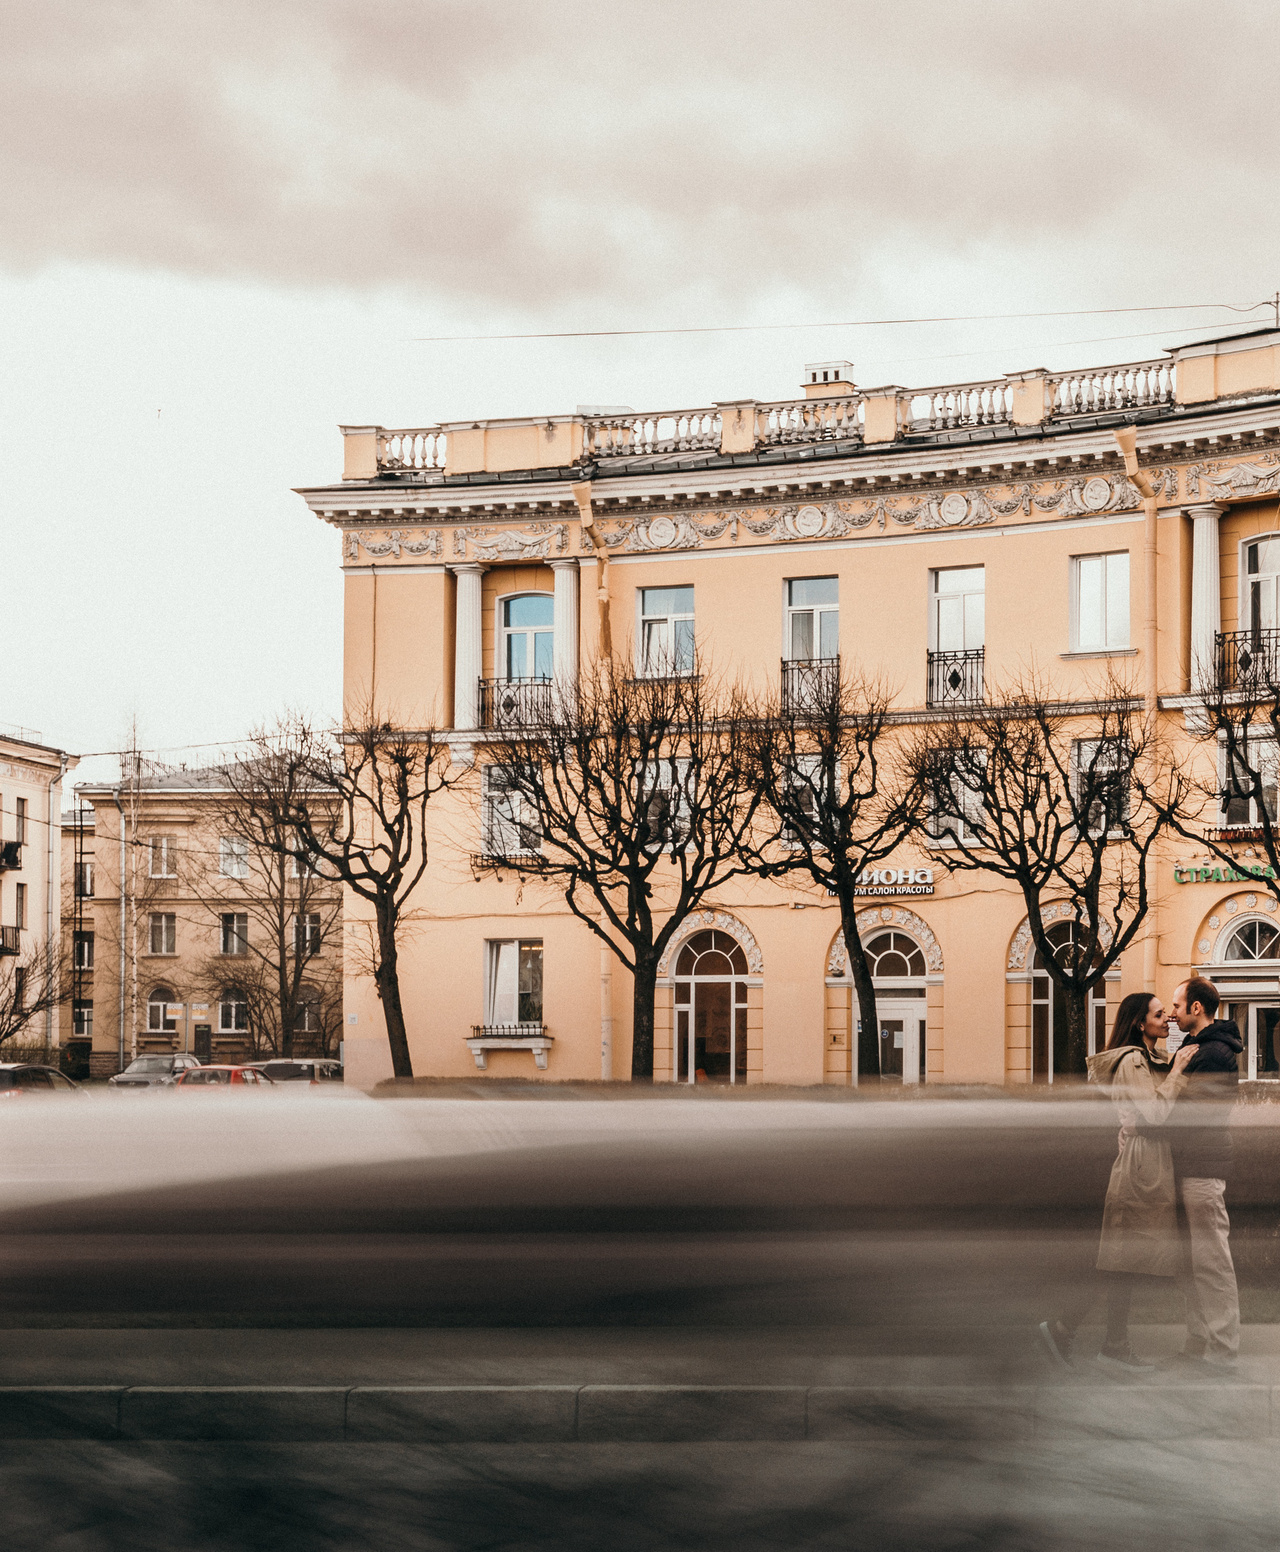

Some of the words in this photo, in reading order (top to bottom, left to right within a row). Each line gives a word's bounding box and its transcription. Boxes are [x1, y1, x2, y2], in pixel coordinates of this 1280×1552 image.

[827, 867, 935, 886] иона
[868, 887, 895, 895] САЛОН
[896, 886, 934, 894] КРАСОТЫ
